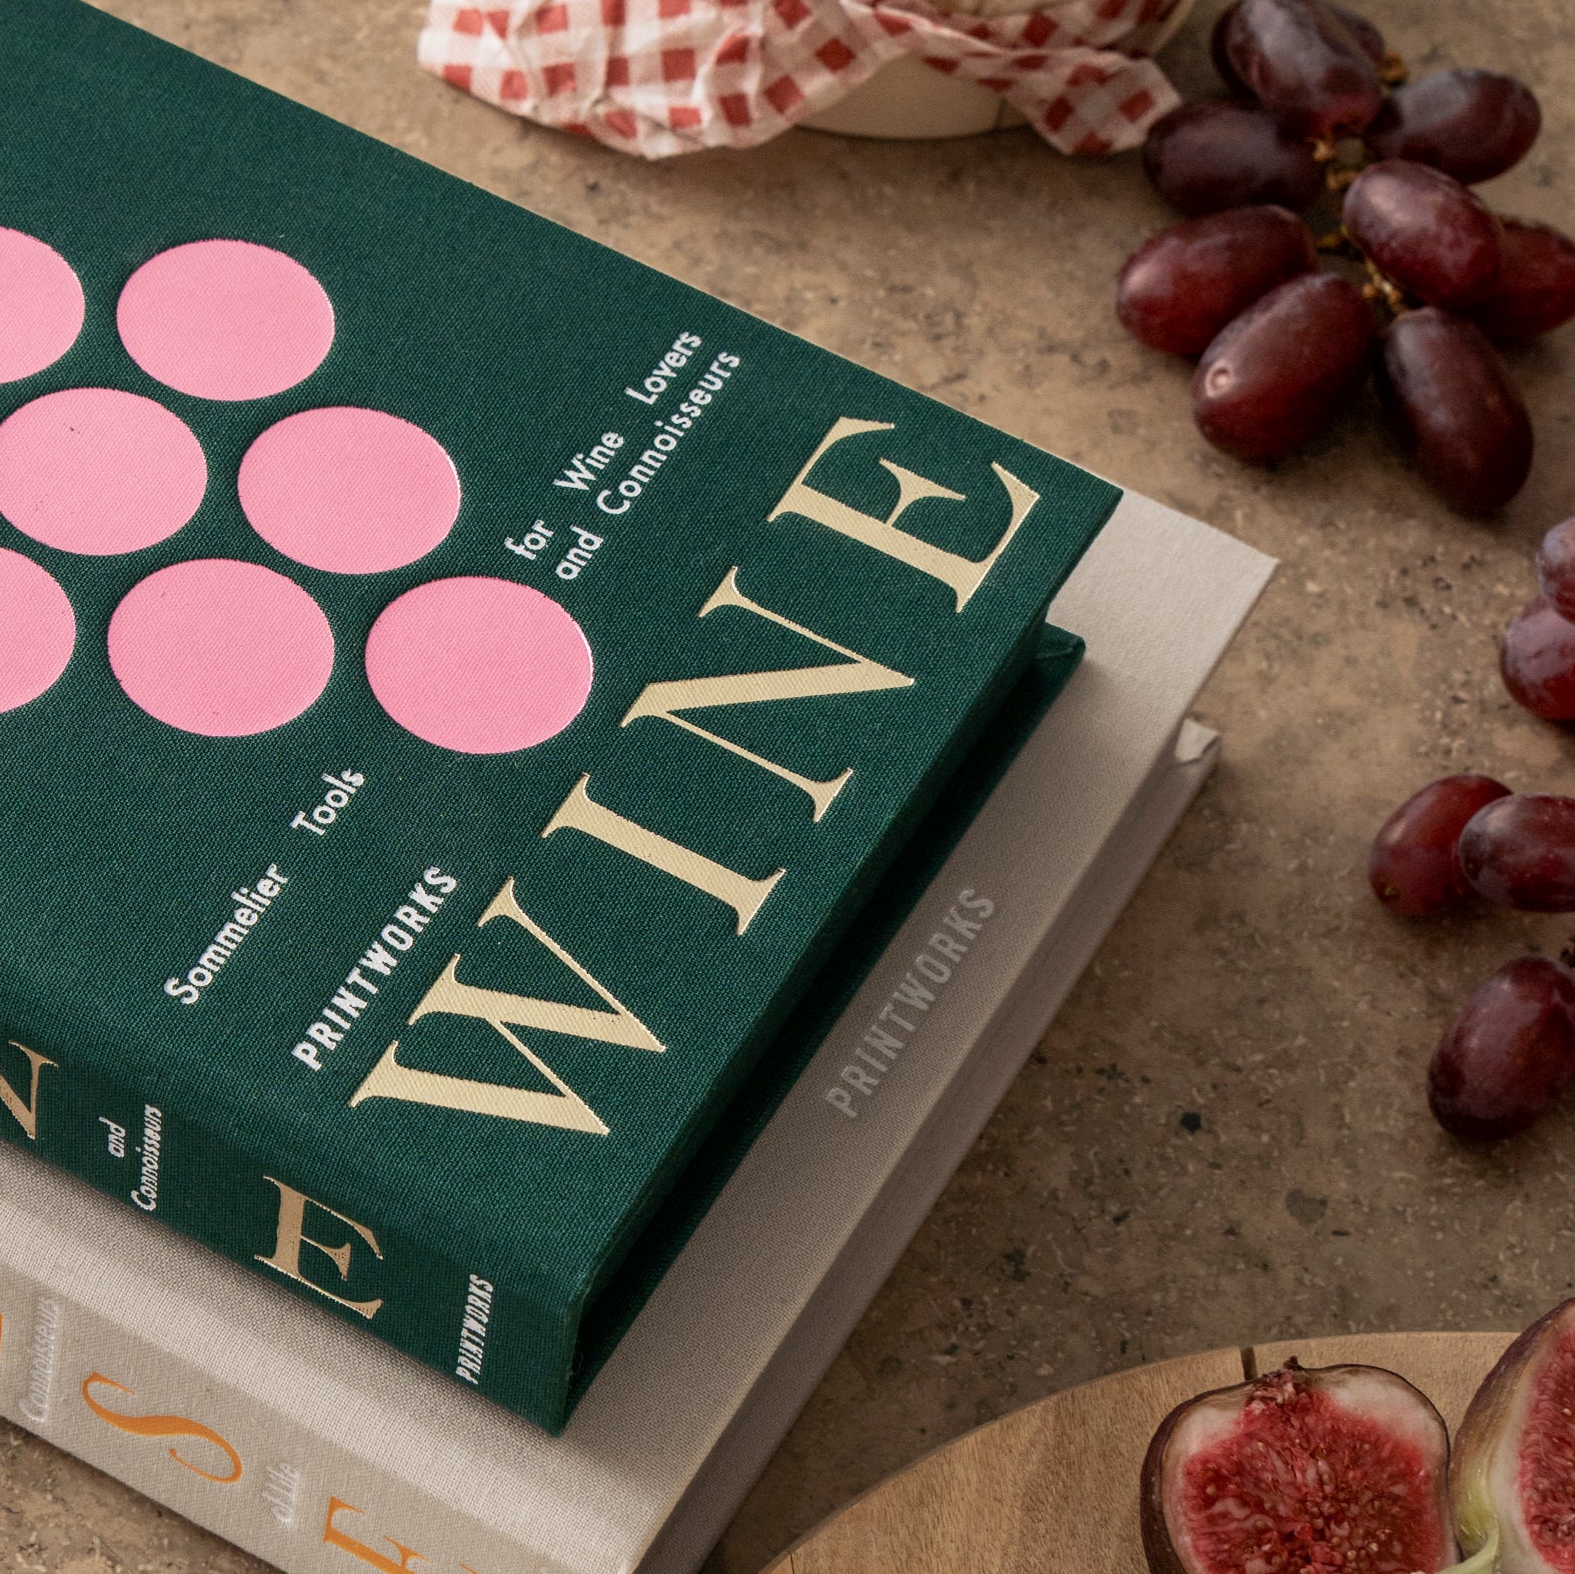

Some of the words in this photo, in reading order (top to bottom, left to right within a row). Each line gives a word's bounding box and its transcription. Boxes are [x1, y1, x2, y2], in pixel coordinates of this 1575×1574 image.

[504, 519, 554, 561] for
[553, 431, 625, 491] Wine
[625, 331, 702, 405] Lovers
[555, 525, 604, 581] and
[596, 351, 740, 515] Connoisseurs
[164, 863, 288, 1005] Sommelier
[290, 769, 366, 836] Tools
[348, 415, 1040, 1137] WINE
[291, 866, 458, 1072] PRINTWORKS
[825, 887, 996, 1119] PRINTWORKS
[98, 1116, 126, 1158] and
[130, 1104, 163, 1212] Connoisseurs
[455, 1273, 494, 1385] PRINTWORKS
